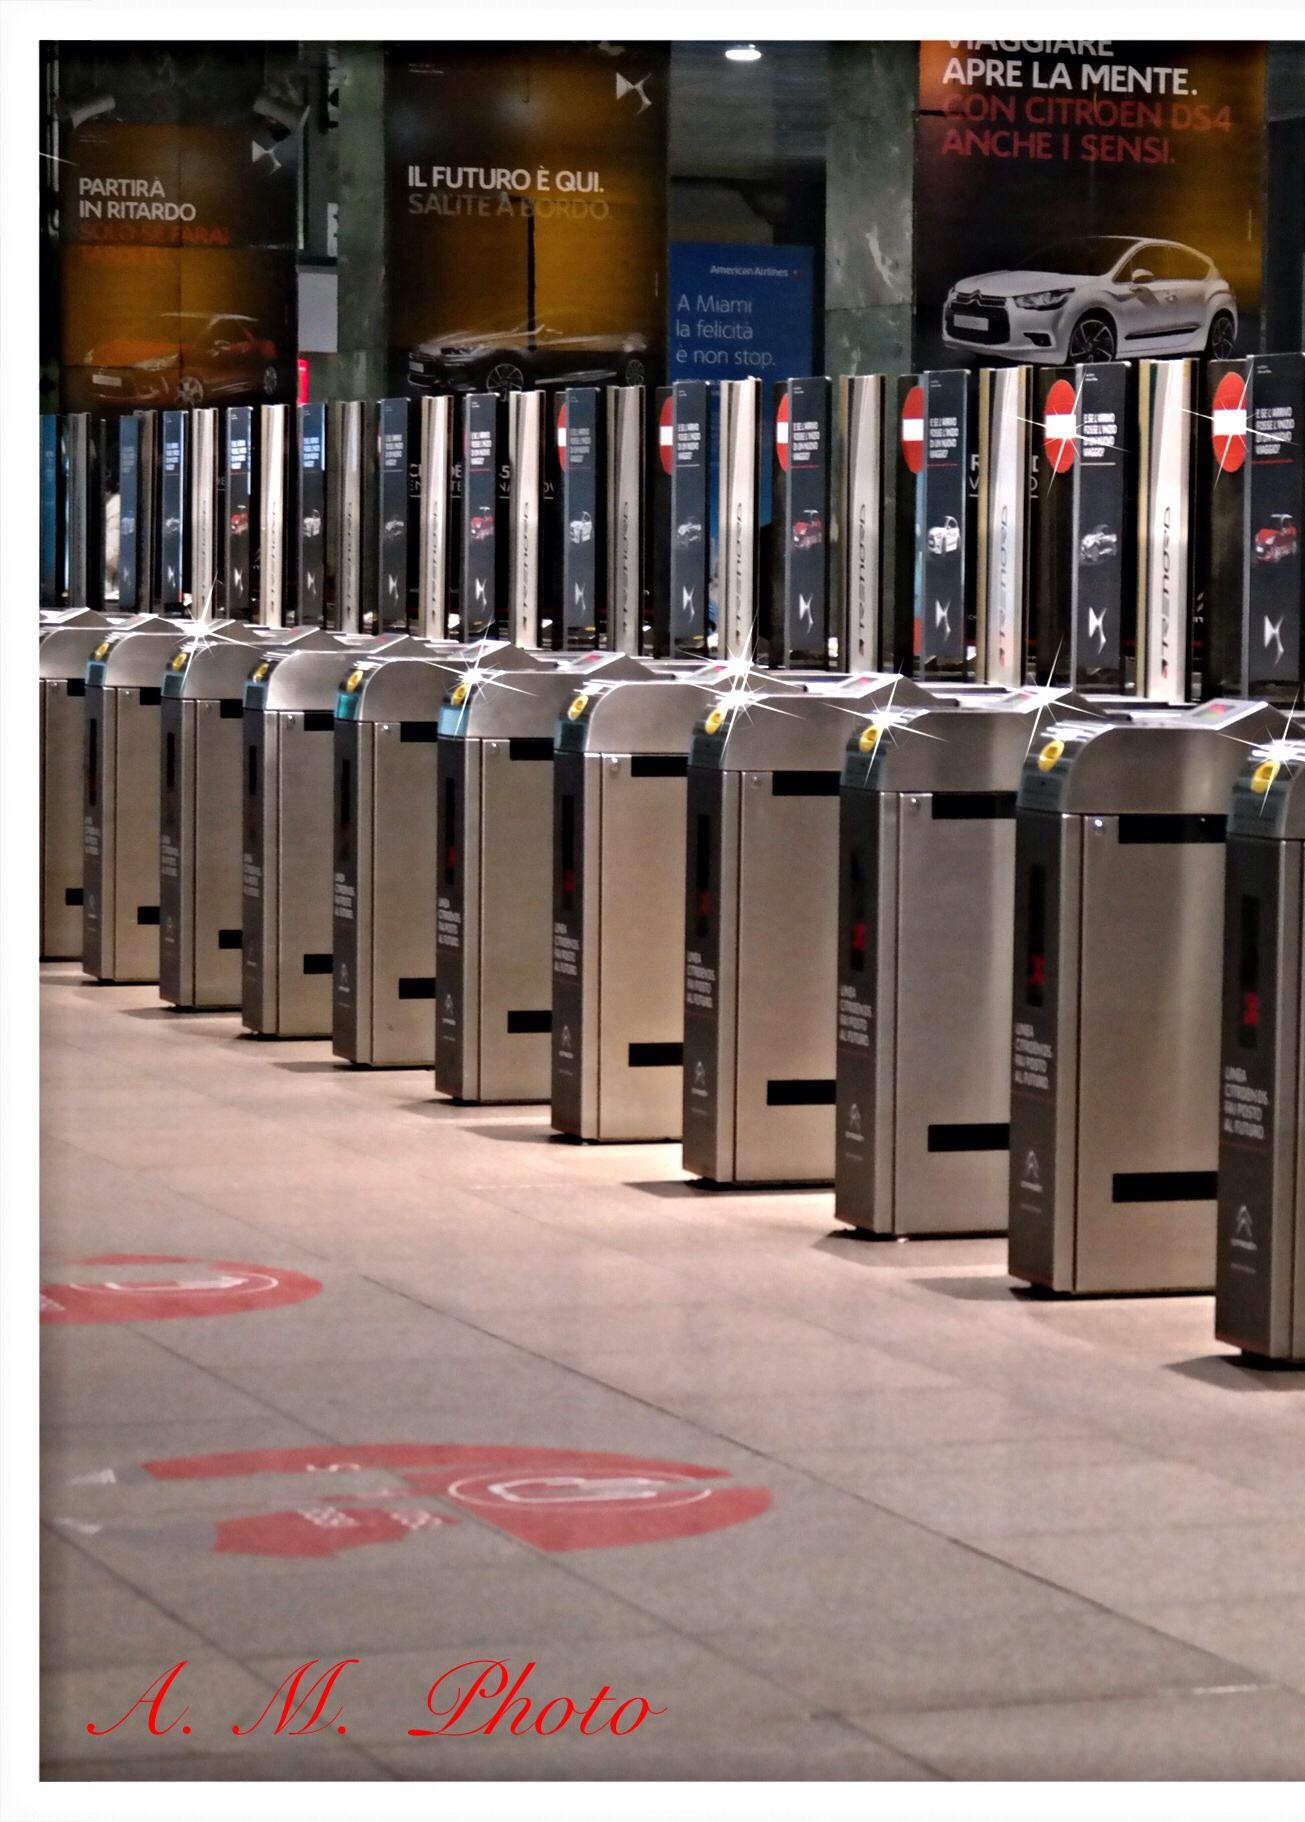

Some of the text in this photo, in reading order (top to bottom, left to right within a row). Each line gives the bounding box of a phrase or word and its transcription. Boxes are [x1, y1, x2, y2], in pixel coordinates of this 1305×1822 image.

[942, 57, 1199, 100] APRE LA MENTE.
[941, 94, 1017, 122] CON
[1170, 103, 1233, 132] DS4
[940, 128, 1176, 165] ANCHE I SENSI.
[79, 177, 166, 199] PARTIRÀ
[408, 165, 605, 193] IL FUTURO È QUI.
[79, 199, 197, 223] IN RITARDO
[408, 192, 493, 217] SALITE
[497, 191, 516, 217] A
[710, 266, 789, 278] American Airlines
[677, 294, 753, 314] A Miami
[676, 320, 754, 340] la felicità
[676, 344, 777, 370] è non stop.
